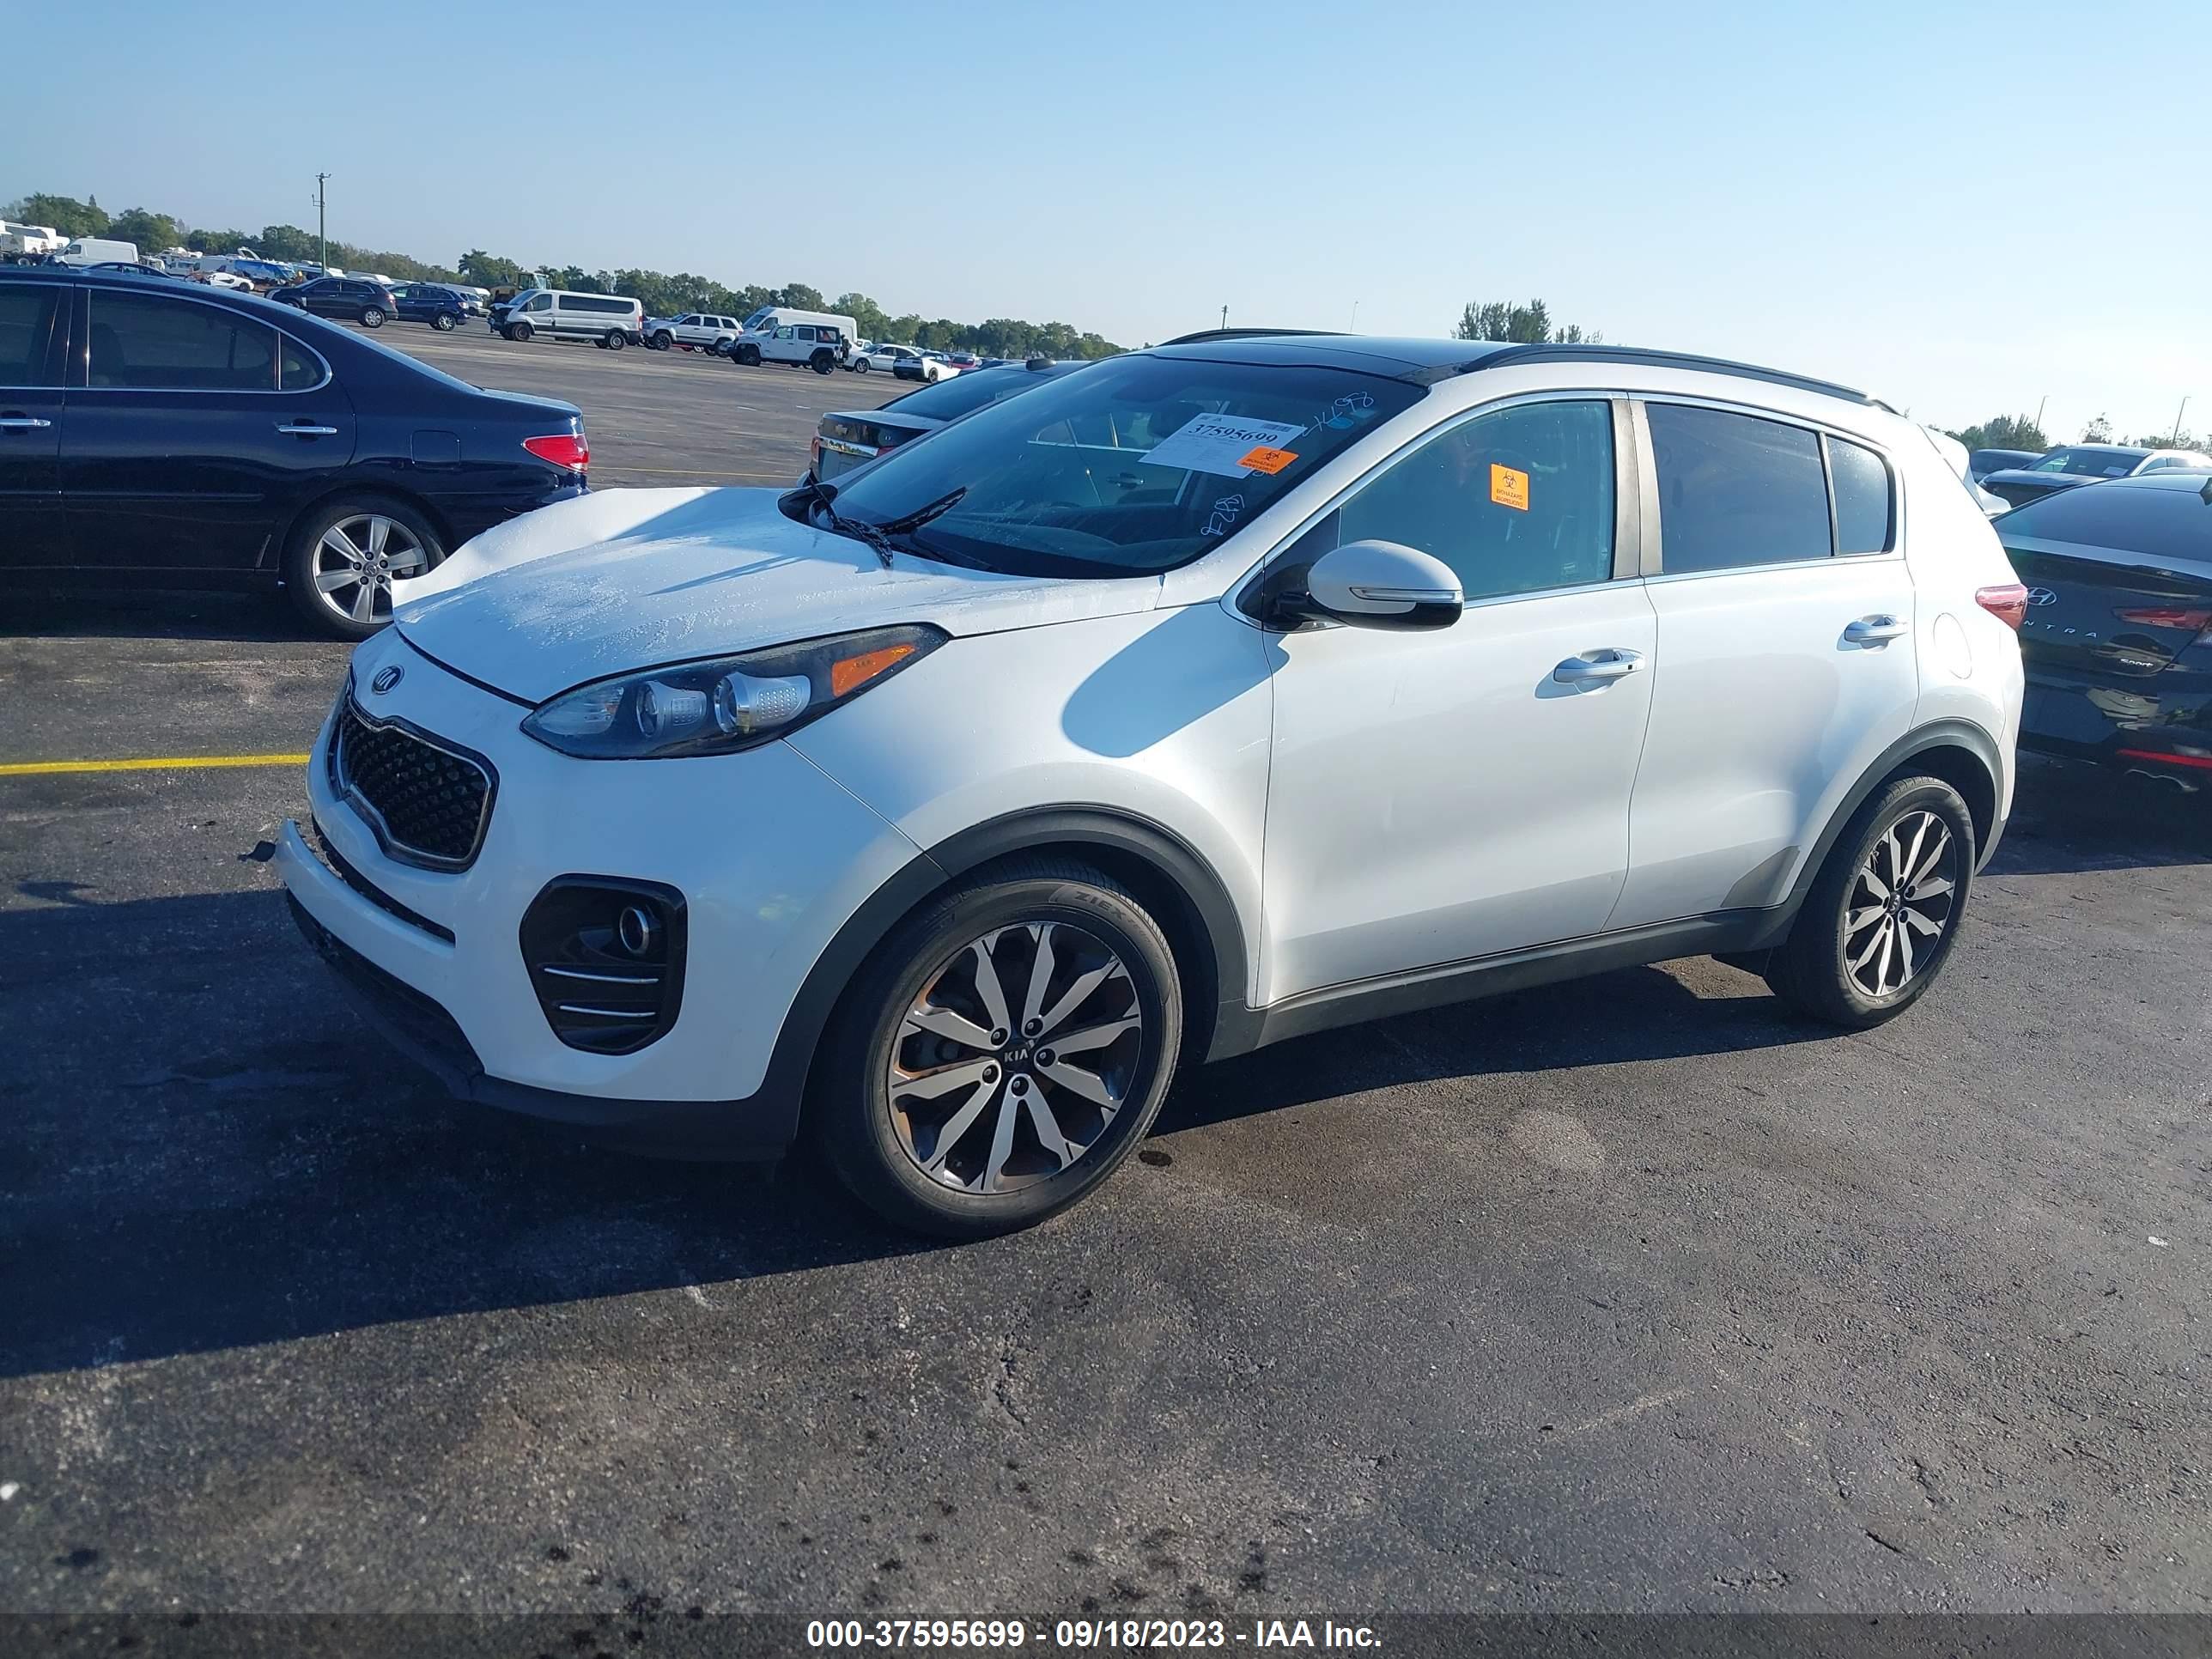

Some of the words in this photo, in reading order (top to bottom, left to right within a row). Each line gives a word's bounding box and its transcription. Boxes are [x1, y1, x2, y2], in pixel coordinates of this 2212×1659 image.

[1188, 424, 1279, 443] 37595699
[2024, 619, 2097, 638] NTRA
[1073, 890, 1127, 921] ZIEX
[1005, 1048, 1029, 1062] KIA
